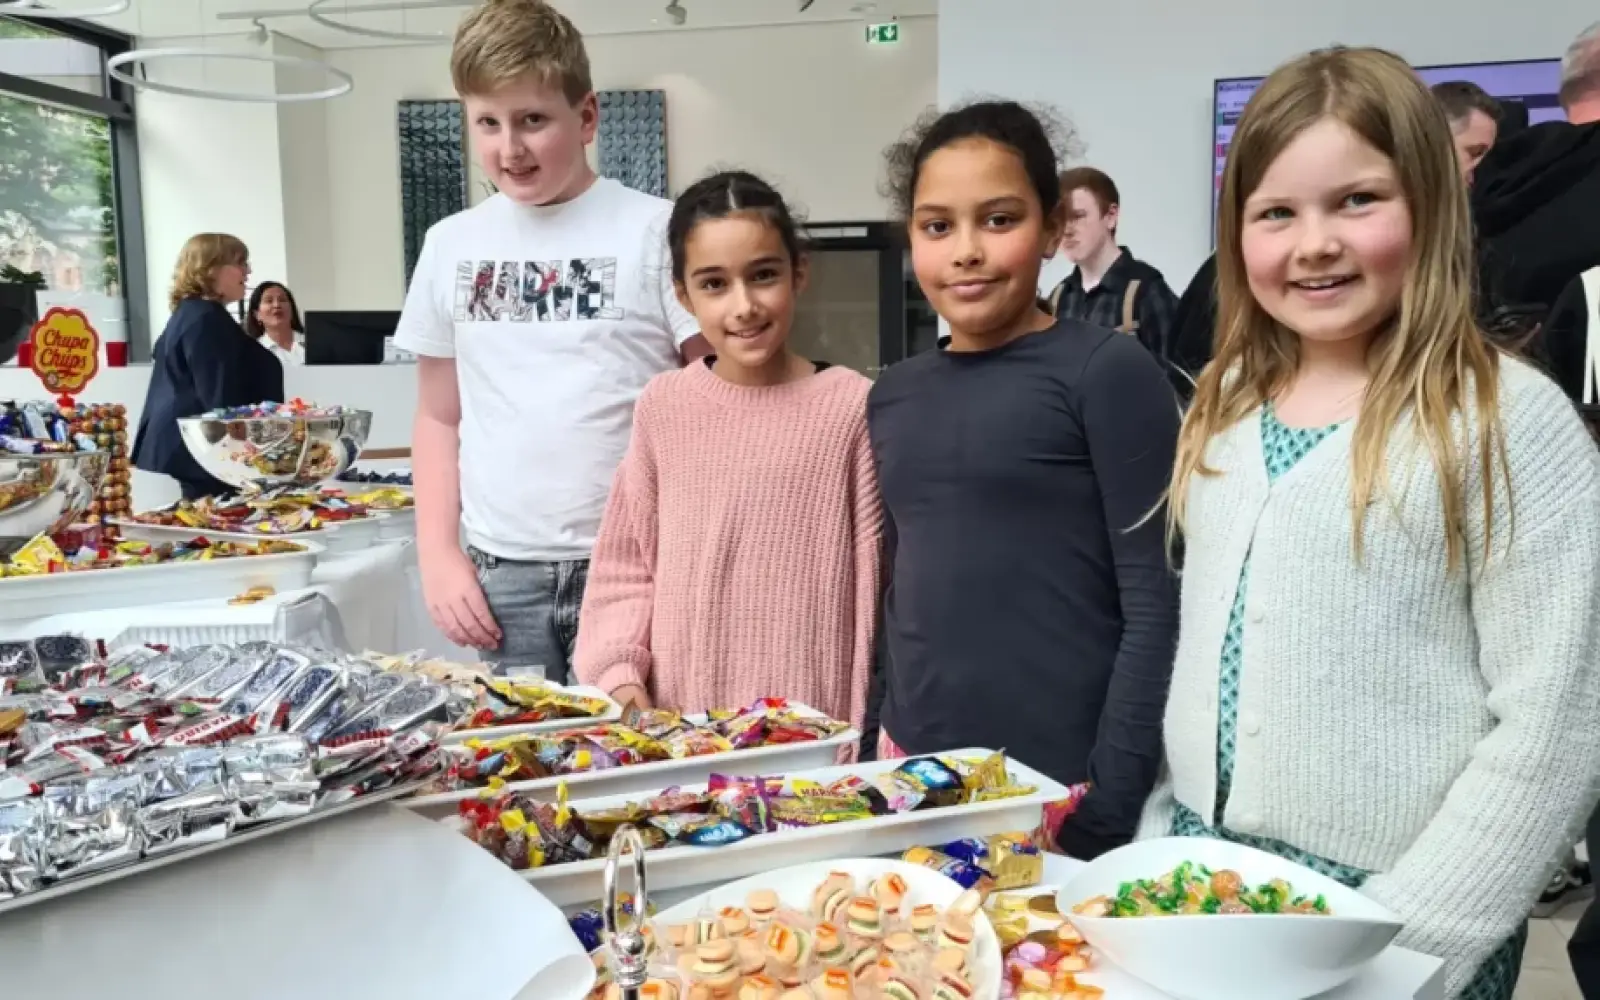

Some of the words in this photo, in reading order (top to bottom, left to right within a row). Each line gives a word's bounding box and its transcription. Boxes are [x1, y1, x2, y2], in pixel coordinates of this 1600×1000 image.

[454, 257, 625, 322] MARVEL
[43, 329, 90, 353] Chupa
[41, 348, 88, 371] Chups
